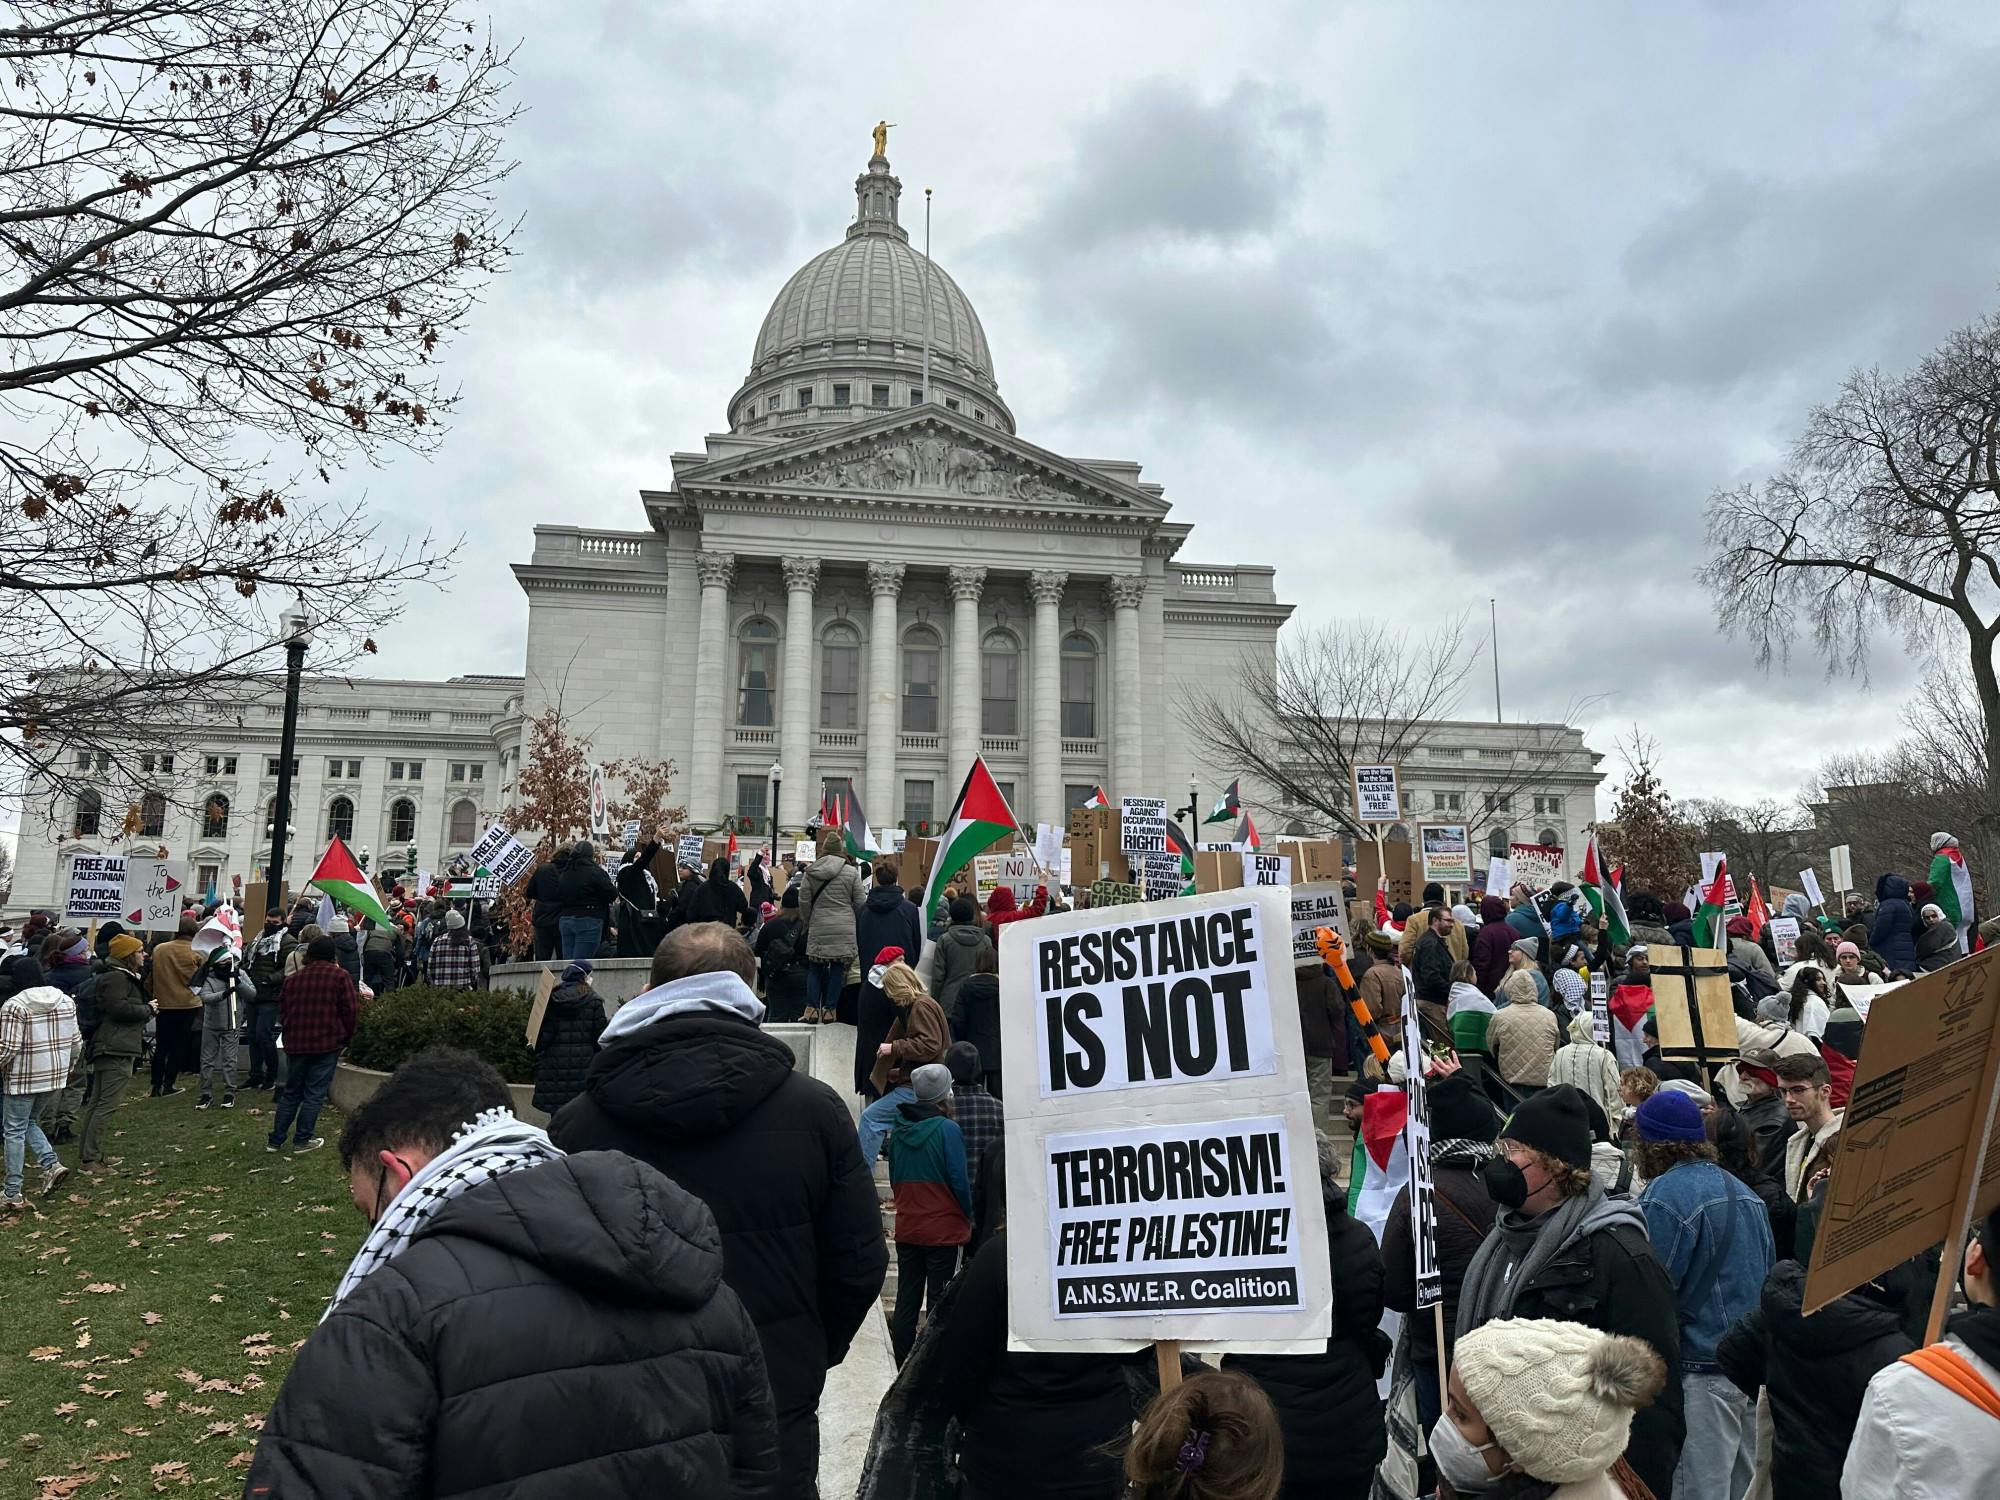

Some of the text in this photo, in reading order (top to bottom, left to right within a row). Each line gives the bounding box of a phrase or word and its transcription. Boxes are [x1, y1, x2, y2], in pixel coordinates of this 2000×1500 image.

[1358, 784, 1395, 792] PALESTINE
[1123, 798, 1166, 809] RESISTANCE
[1364, 793, 1391, 801] WILL BE
[1129, 808, 1159, 817] AGAINST
[1369, 802, 1388, 810] FREE!
[1122, 816, 1166, 826] OCCUPATION
[1124, 826, 1165, 836] IS A HUMAN
[470, 827, 505, 862] FREE ALL
[480, 833, 513, 867] PALESTINIAN
[1123, 835, 1165, 851] RIGHT!
[74, 858, 126, 872] FREE ALL
[492, 844, 525, 878] POLITICAL
[501, 849, 532, 883] PRISONERS
[1144, 861, 1174, 871] AGAINST
[1255, 856, 1281, 872] END
[153, 864, 168, 877] To
[1005, 861, 1024, 877] NO
[72, 871, 125, 882] PALESTINIAN
[1256, 871, 1279, 886] ALL
[145, 881, 165, 899] the
[473, 877, 500, 891] FREE
[1092, 881, 1141, 899] CEASE
[1152, 880, 1179, 890] HUMAN
[71, 888, 122, 900] POLITICAL
[68, 901, 121, 912] PRISONERS
[1316, 896, 1338, 910] ALL
[1039, 907, 1258, 993] RESISTANCE
[1046, 969, 1252, 1092] IS NOT
[1051, 1132, 1286, 1209] TERRORISM!
[1057, 1208, 1291, 1267] FREE PALESTINE!
[1064, 1276, 1291, 1306] A.N.S.W.E.R. Coalition
